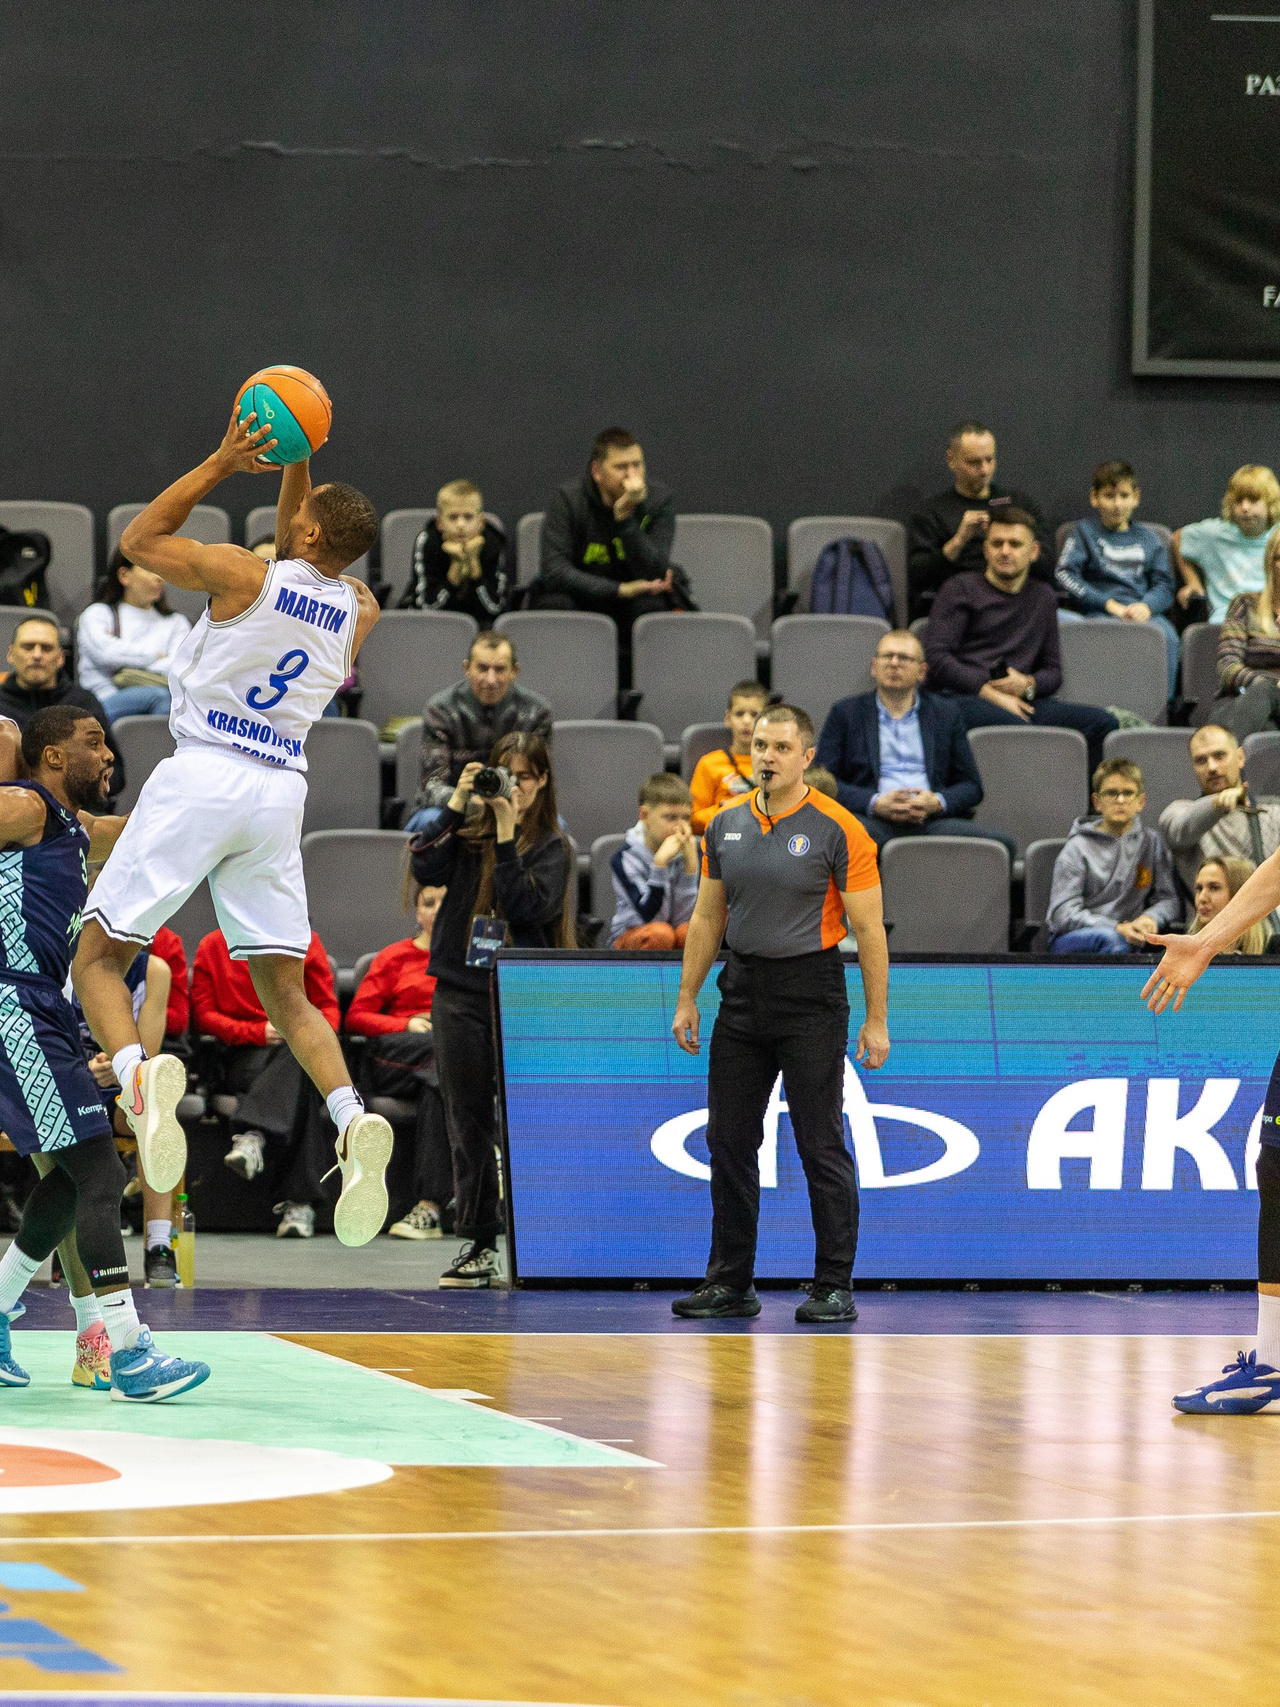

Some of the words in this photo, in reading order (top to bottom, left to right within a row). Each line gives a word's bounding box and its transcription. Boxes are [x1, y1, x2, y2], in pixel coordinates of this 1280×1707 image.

[273, 586, 348, 634] MARTIN
[245, 648, 310, 711] 3
[1026, 1077, 1266, 1191] AK
